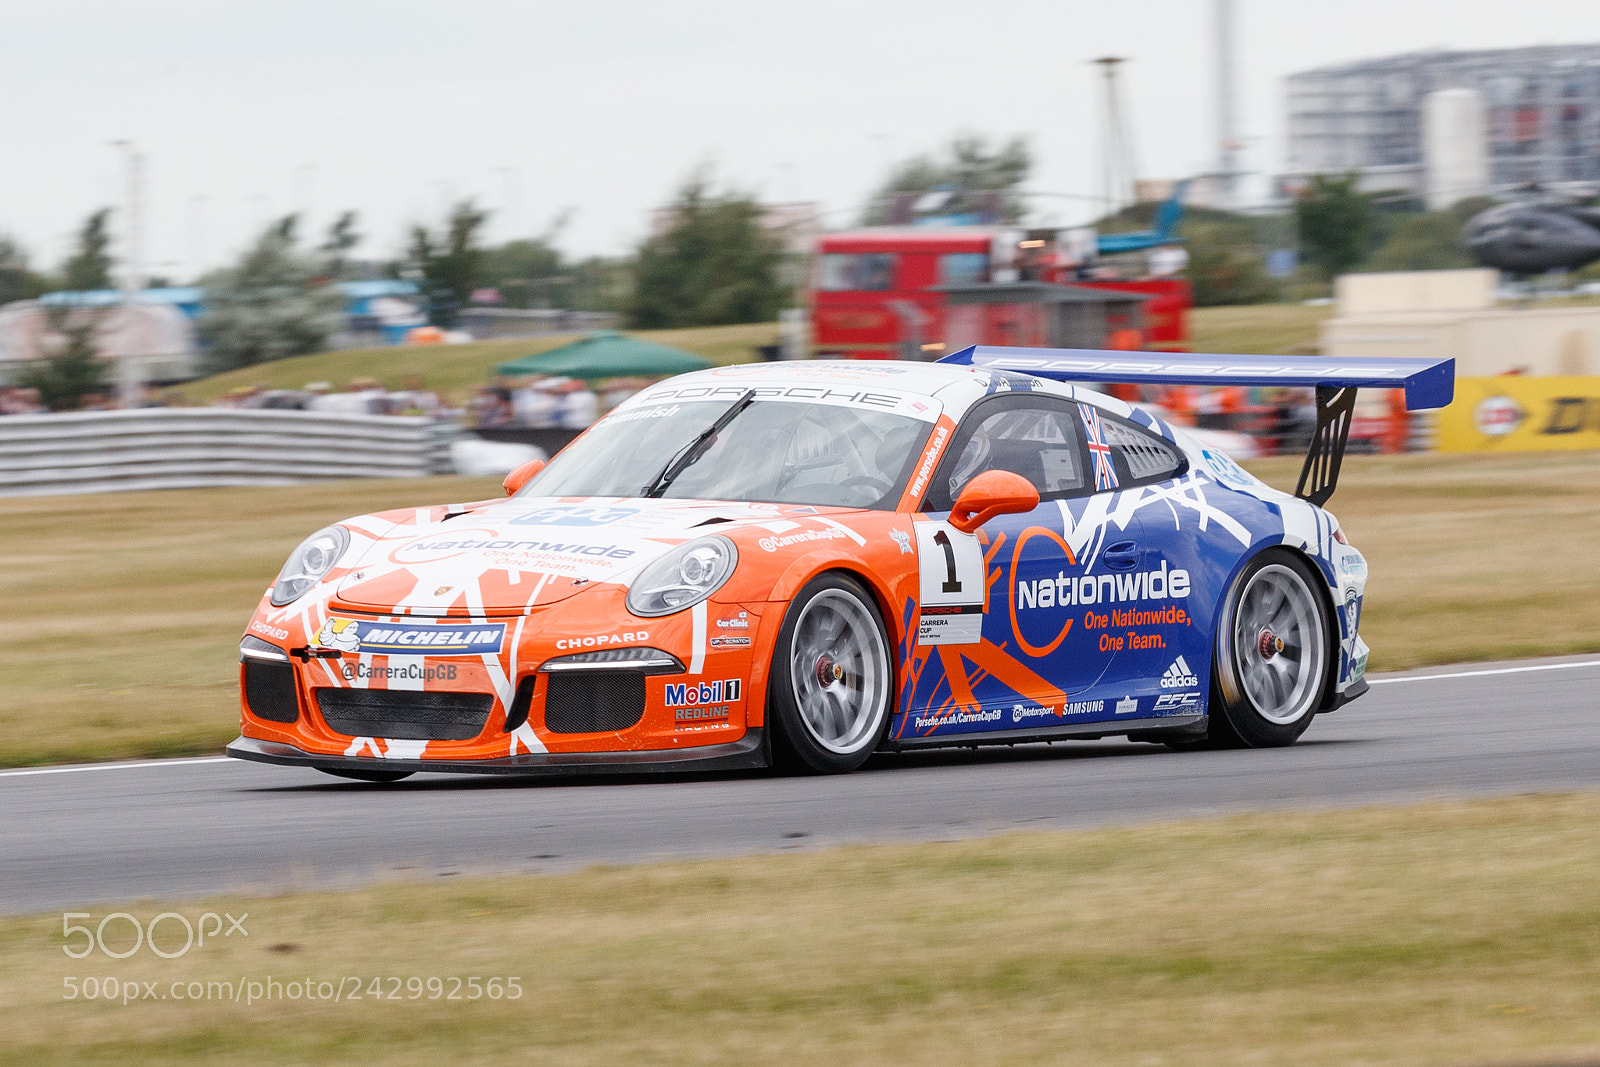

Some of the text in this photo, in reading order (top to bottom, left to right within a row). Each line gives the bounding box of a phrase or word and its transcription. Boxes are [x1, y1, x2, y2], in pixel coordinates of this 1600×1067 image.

[983, 358, 1396, 375] PORSCHE
[641, 386, 902, 408] PORSCHE
[910, 426, 949, 498] www.porsche.co.uk
[514, 506, 640, 525] PPG
[403, 538, 637, 559] Nationwide
[758, 526, 847, 552] @CarreraCupGB
[933, 530, 962, 594] 1
[1018, 560, 1191, 610] Nationwide
[1084, 605, 1192, 629] One Nationwide,
[251, 620, 289, 640] CHOPARD
[362, 628, 501, 645] MICHELIN
[556, 631, 650, 650] CHOPARD
[1099, 632, 1167, 651] One Team.
[341, 662, 458, 682] @CarreraCupGB
[1160, 674, 1199, 688] adidas
[665, 681, 722, 706] Mobil
[675, 705, 729, 720] REDLINE
[1062, 700, 1104, 716] SAMSUNG
[914, 709, 1002, 728] Porsche.co.uk/CarreraCupGB
